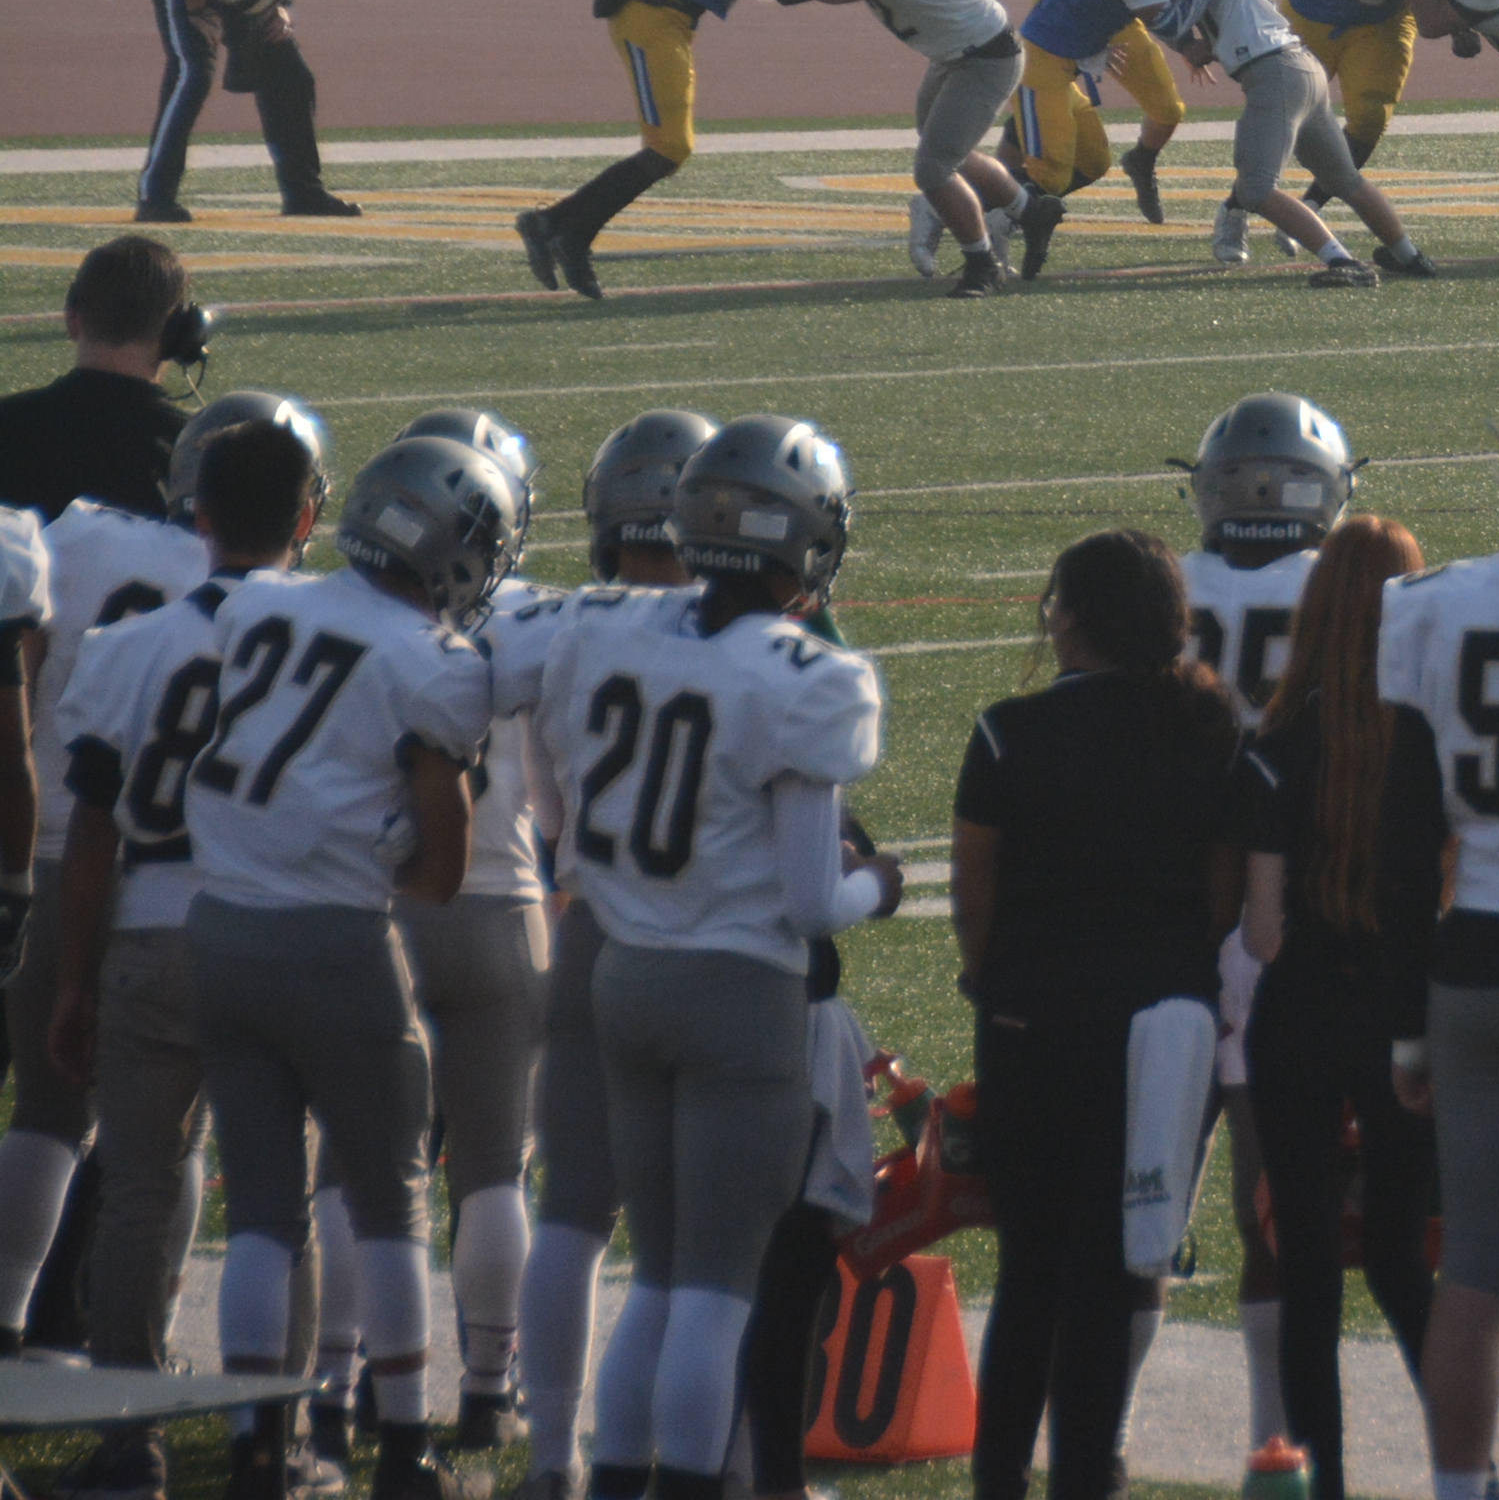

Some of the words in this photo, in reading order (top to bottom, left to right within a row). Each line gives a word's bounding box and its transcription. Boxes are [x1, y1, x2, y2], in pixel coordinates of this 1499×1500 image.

[682, 545, 761, 572] Riddell
[1223, 521, 1303, 539] Riddell
[190, 612, 372, 807] 27
[574, 674, 713, 879] 20
